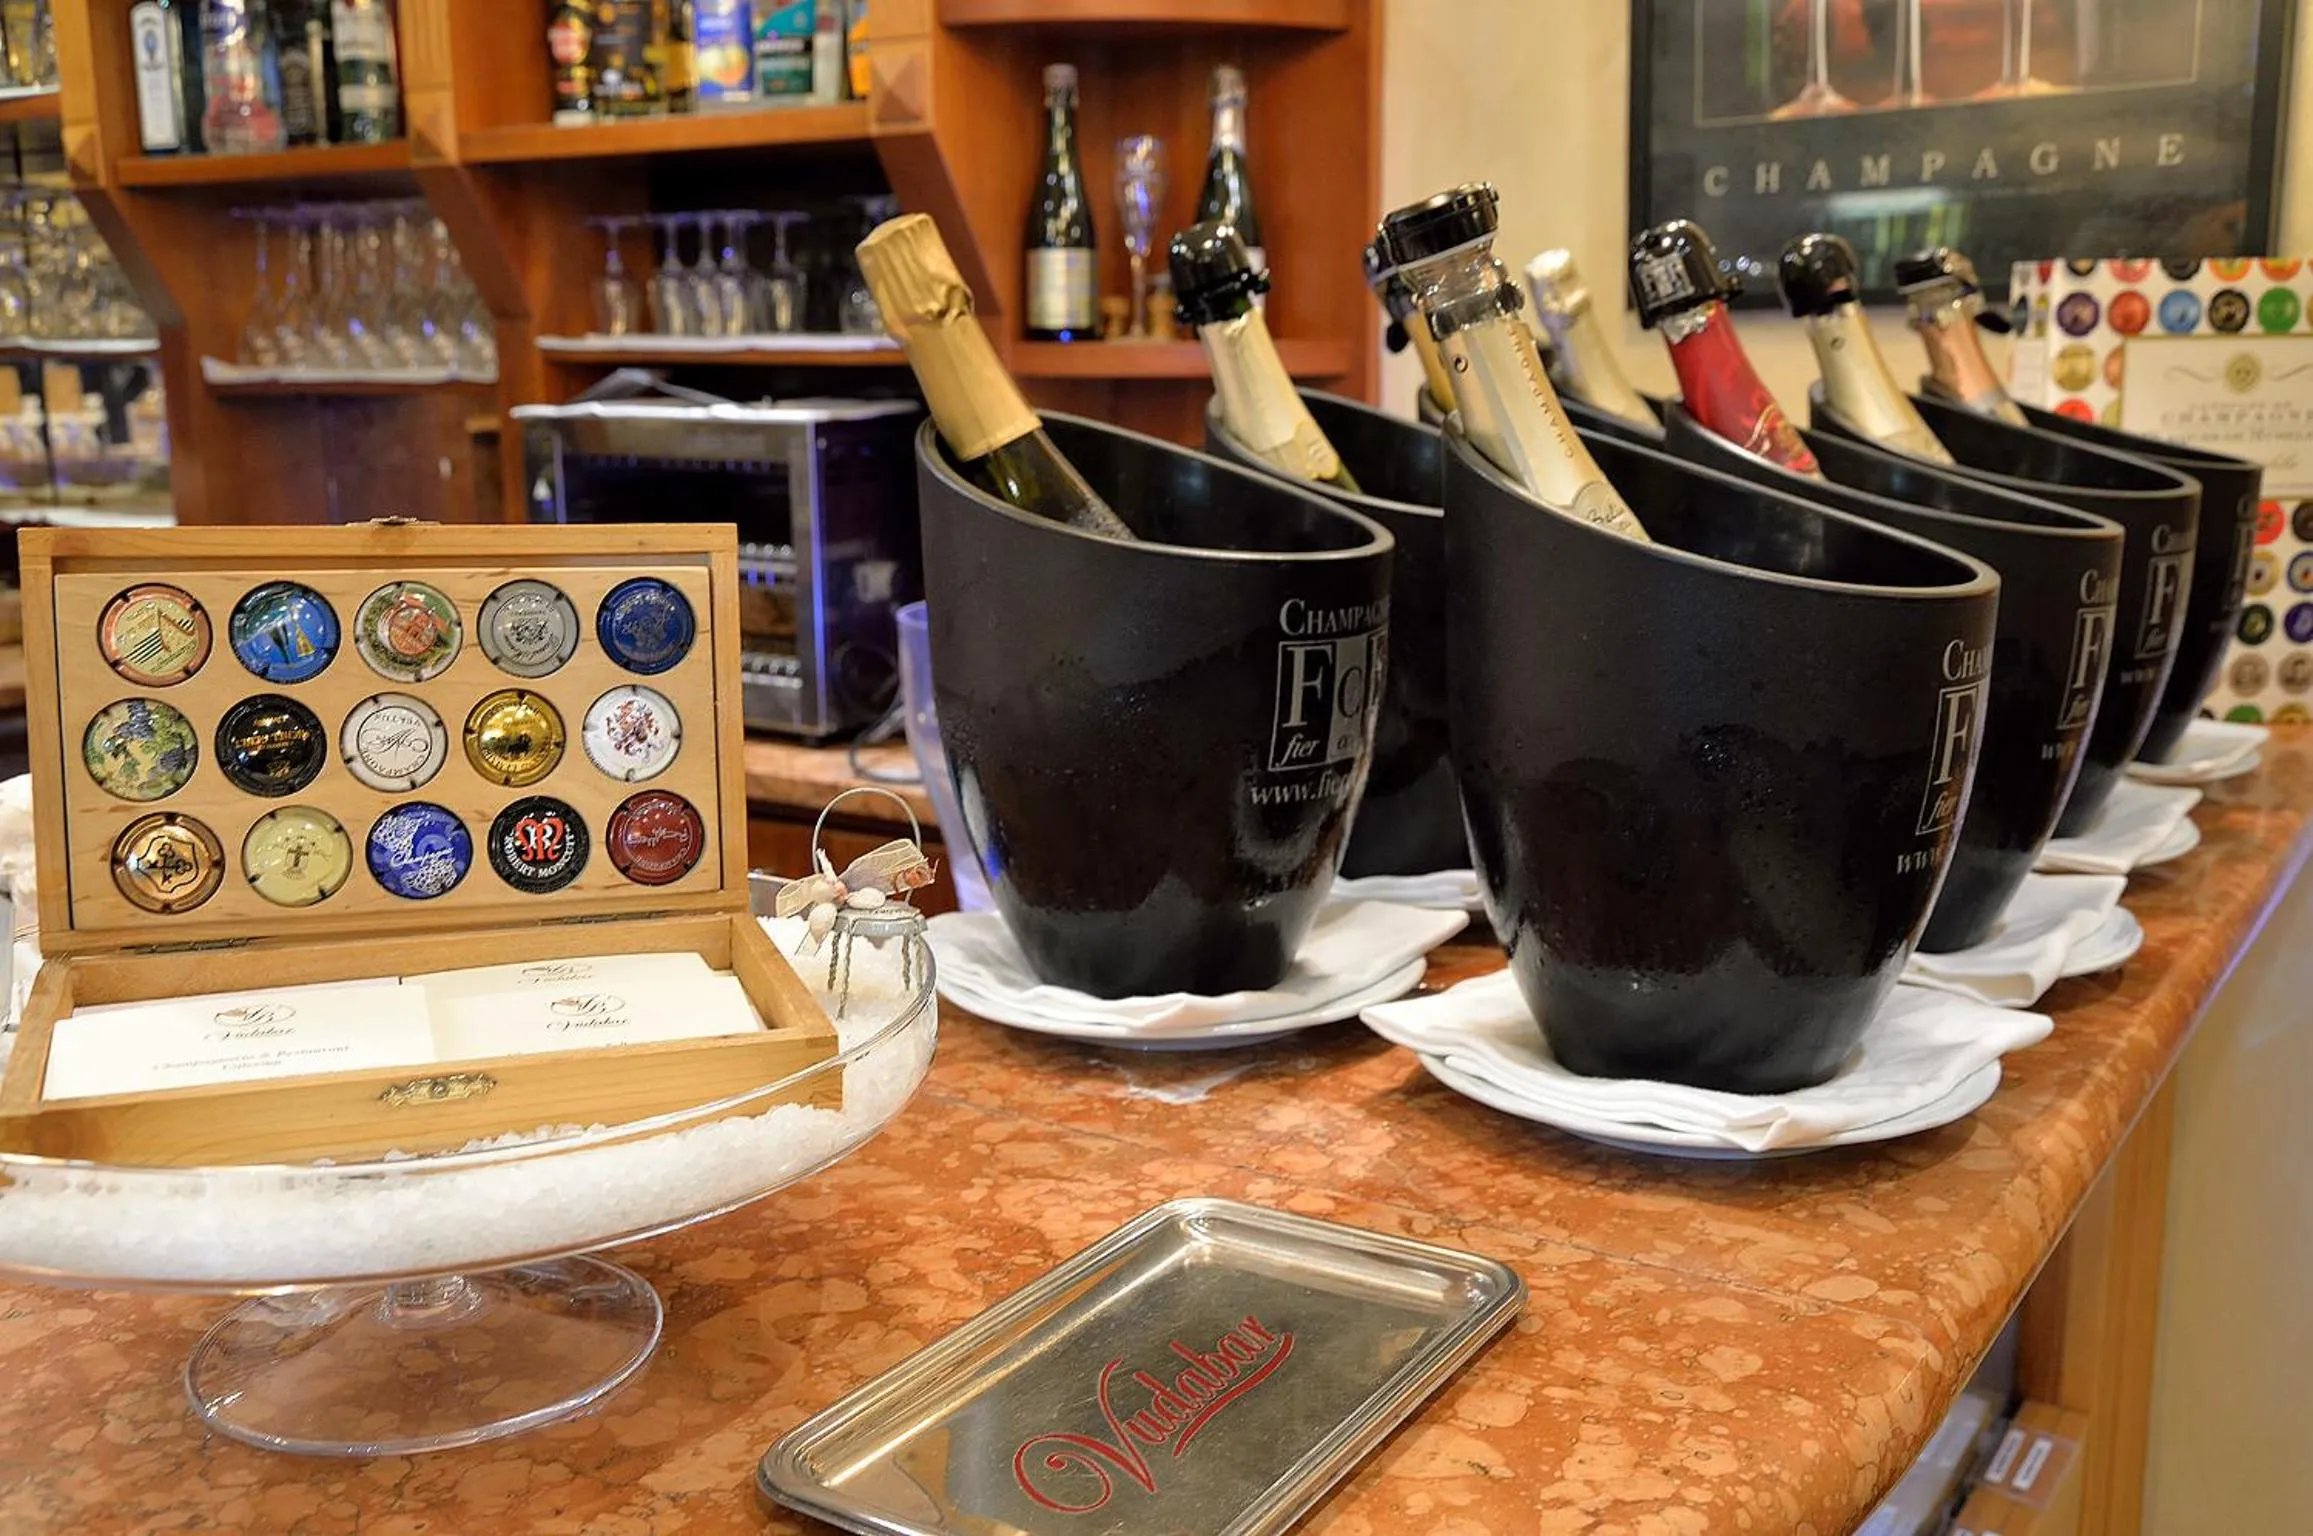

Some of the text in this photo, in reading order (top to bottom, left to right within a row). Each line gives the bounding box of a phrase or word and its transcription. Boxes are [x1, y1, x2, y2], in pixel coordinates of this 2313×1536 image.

[1702, 133, 2186, 197] CHAMPAGNE
[1934, 690, 1979, 785] F
[1013, 1314, 1296, 1514] Vudabar
